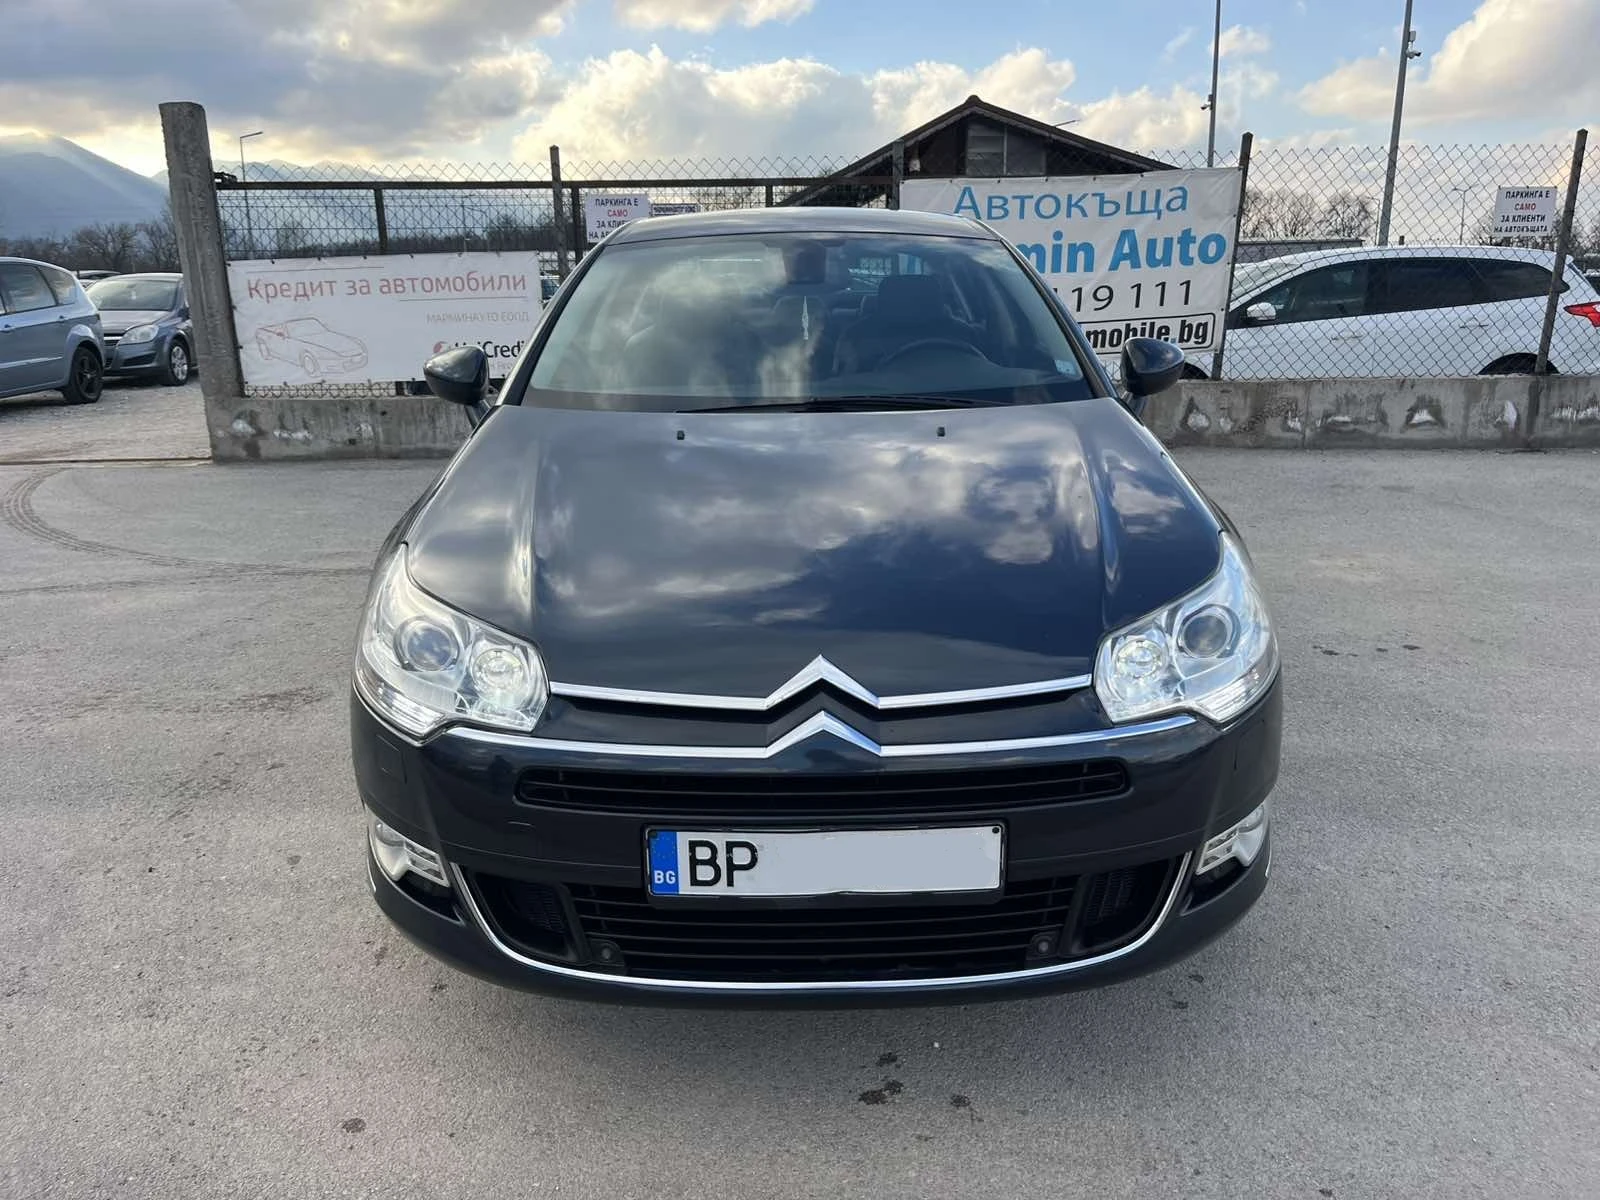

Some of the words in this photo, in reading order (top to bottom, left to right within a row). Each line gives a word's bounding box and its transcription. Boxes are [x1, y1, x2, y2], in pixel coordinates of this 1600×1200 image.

[1505, 190, 1543, 199] ПАРКИНГА
[595, 198, 632, 206] ПАРКИНГА
[953, 186, 1189, 220] Автокъща
[1514, 203, 1536, 211] САМО
[607, 209, 628, 217] САМО
[1500, 214, 1510, 223] ЗА
[1511, 214, 1546, 223] КЛИЕНТИ
[596, 220, 606, 229] ЗА
[588, 231, 599, 240] НА
[1108, 227, 1227, 272] Auto
[247, 279, 337, 304] Кредит
[344, 279, 372, 296] за
[379, 270, 526, 296] автомобили
[1130, 279, 1192, 309] 111
[1085, 319, 1208, 349] mobile.bg
[653, 869, 677, 885] BG
